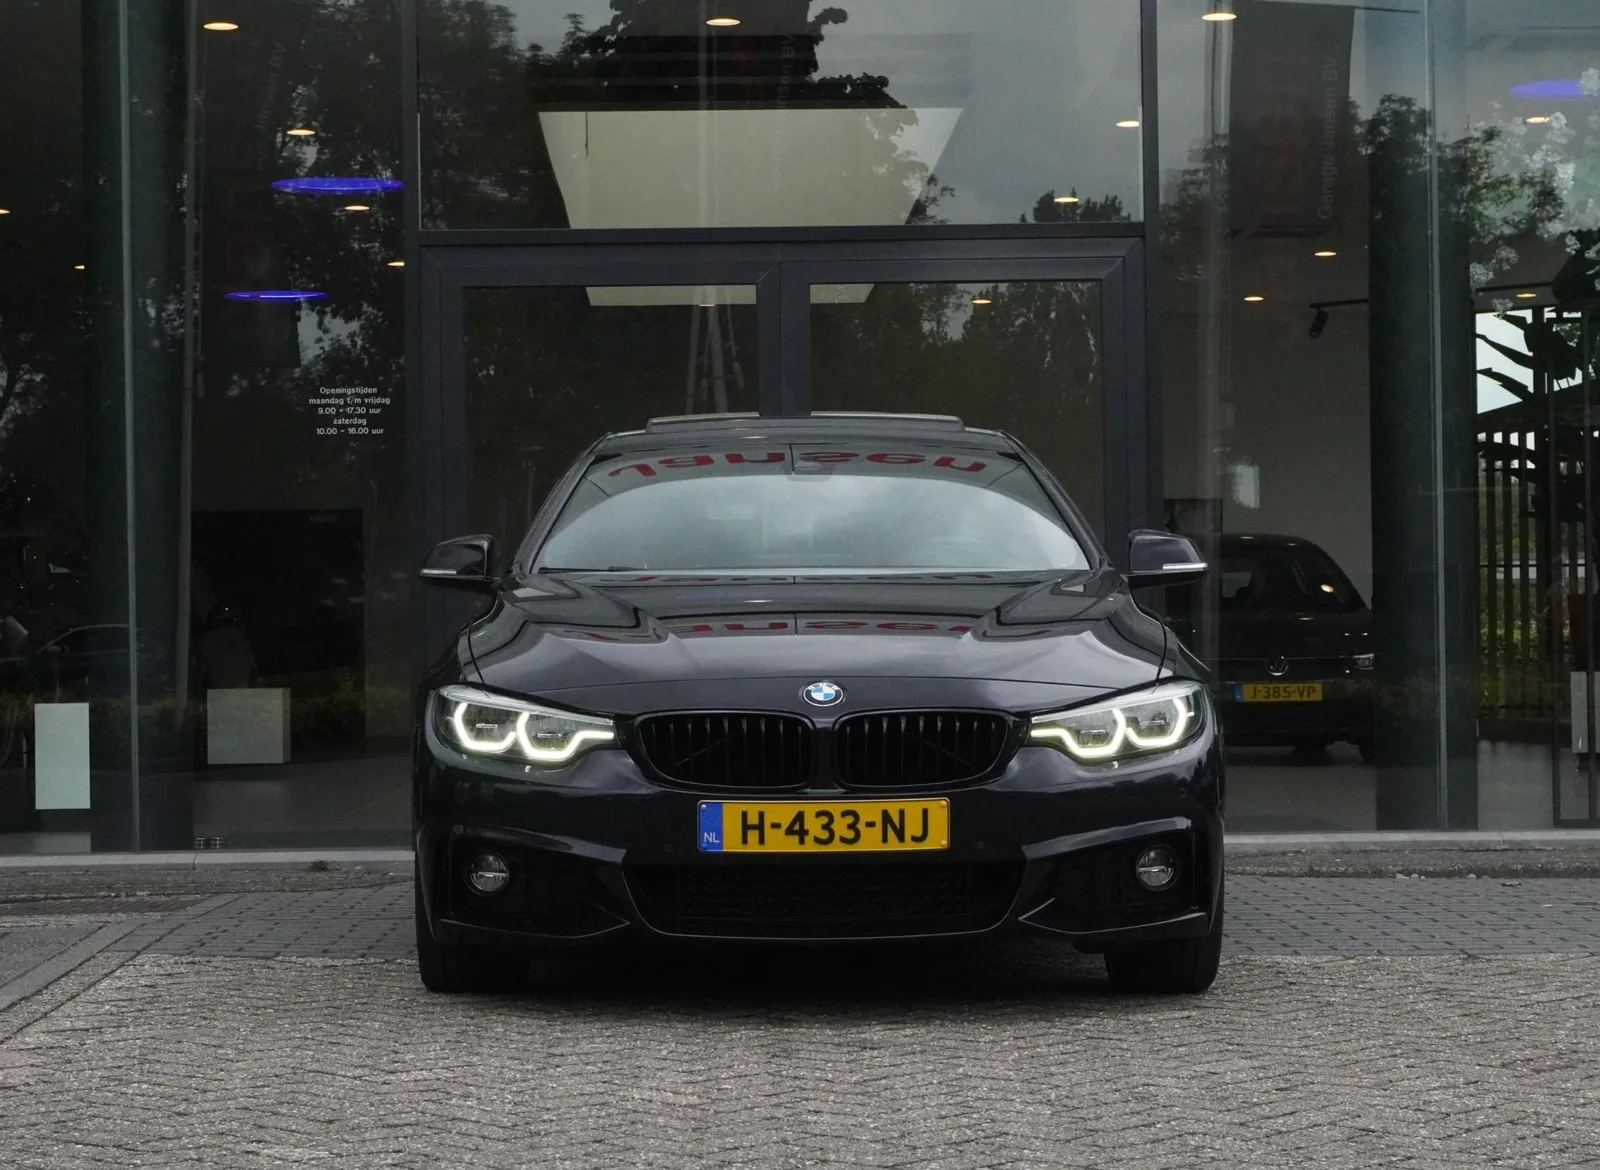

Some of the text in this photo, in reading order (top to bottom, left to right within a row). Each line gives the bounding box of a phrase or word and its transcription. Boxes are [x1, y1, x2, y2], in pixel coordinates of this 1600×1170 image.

[1317, 154, 1338, 219] Garage
[320, 387, 377, 395] Openingstijden
[309, 397, 390, 405] maandag t/m vrijdag
[346, 406, 366, 414] 17.30
[333, 417, 367, 425] zaterdag
[316, 427, 337, 435] 10.00
[1251, 686, 1316, 699] J-385-VP
[741, 808, 929, 845] H-433-NJ
[703, 831, 720, 843] NL
